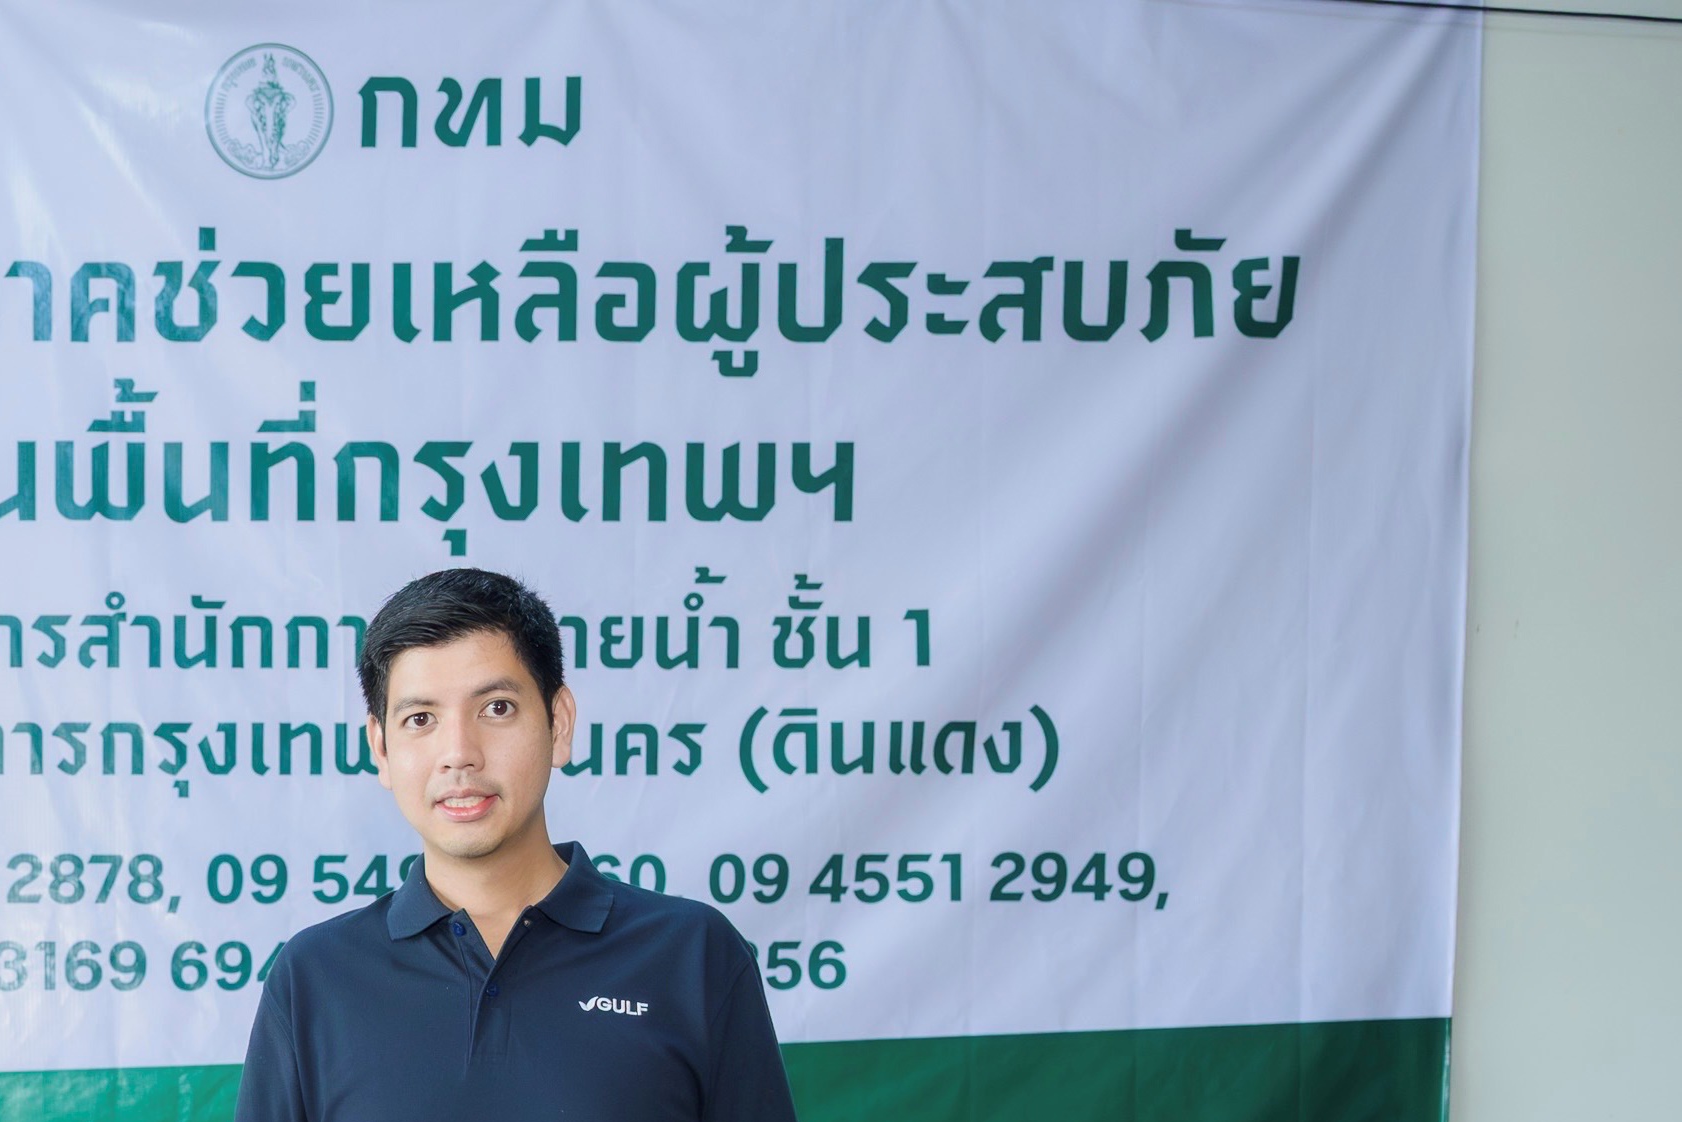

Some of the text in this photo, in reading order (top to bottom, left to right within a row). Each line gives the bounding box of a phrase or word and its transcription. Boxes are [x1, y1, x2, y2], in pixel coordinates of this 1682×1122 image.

[357, 75, 583, 149] กทม
[771, 573, 871, 670] ชั้น
[903, 608, 931, 667] 1
[738, 704, 1060, 792] (ดินแดง)
[6, 852, 182, 914] 2878,
[206, 853, 289, 905] 09
[709, 853, 789, 904] 09
[808, 852, 963, 904] 4551
[989, 850, 1169, 911] 2949,
[596, 997, 649, 1016] GULF
